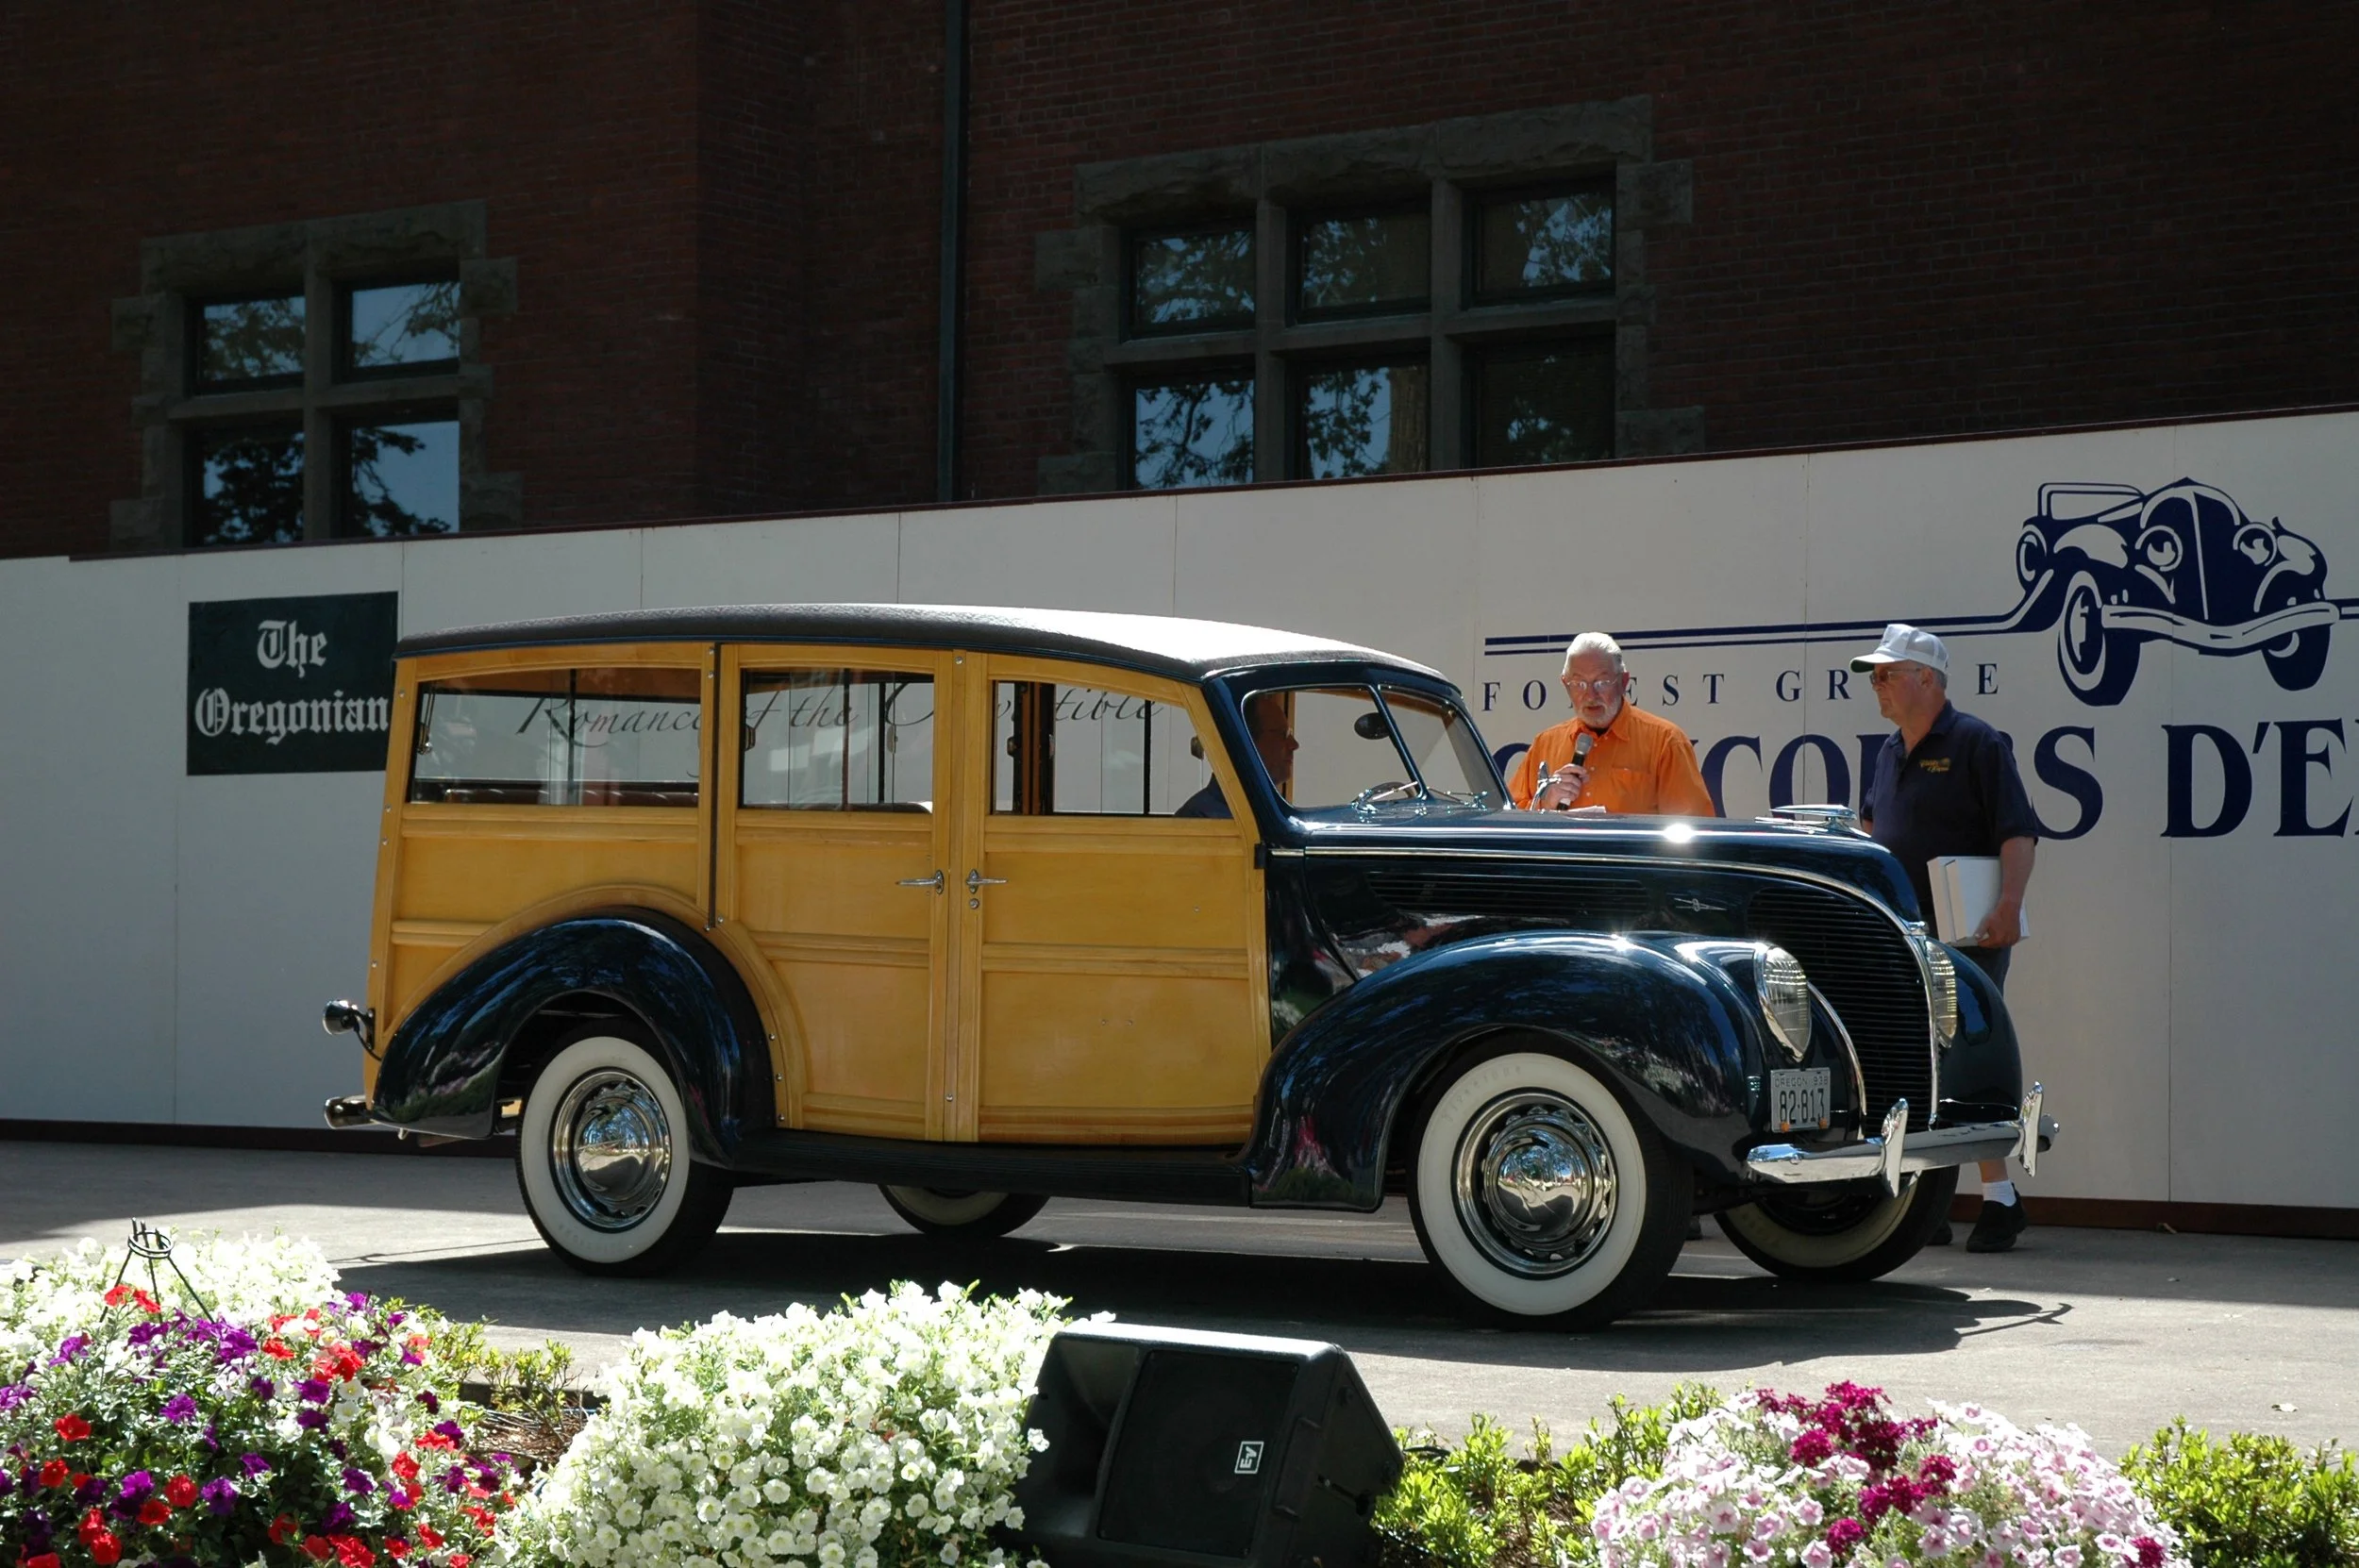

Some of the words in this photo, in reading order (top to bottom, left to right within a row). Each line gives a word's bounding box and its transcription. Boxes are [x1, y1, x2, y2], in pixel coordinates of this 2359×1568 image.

[257, 620, 327, 678] The
[1482, 674, 1724, 712] FOEST
[1776, 663, 1999, 702] GRE
[195, 688, 389, 745] Oregonian
[516, 697, 700, 748] Romanc
[2160, 717, 2359, 838] D'E
[1775, 1077, 1808, 1088] OREGON
